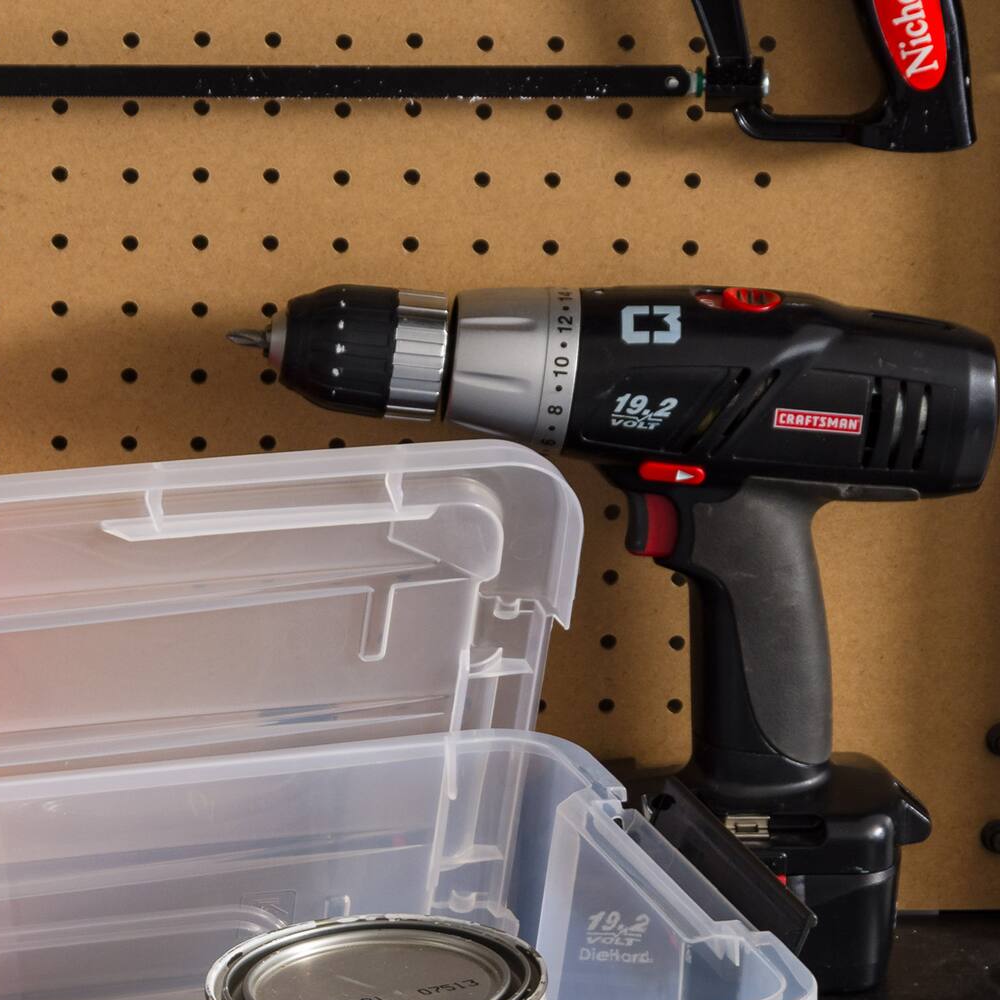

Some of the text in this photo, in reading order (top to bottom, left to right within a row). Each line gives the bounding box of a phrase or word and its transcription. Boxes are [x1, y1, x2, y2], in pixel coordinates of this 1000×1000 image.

[892, 0, 940, 78] Nich
[558, 316, 572, 333] 12
[621, 305, 681, 344] C3
[554, 357, 569, 377] 10
[548, 405, 563, 415] 8
[614, 393, 678, 417] 19.2
[611, 418, 660, 430] VOLT
[780, 412, 858, 430] CRAFTSMAN
[586, 911, 650, 933] 19.2
[417, 979, 480, 996] 07513
